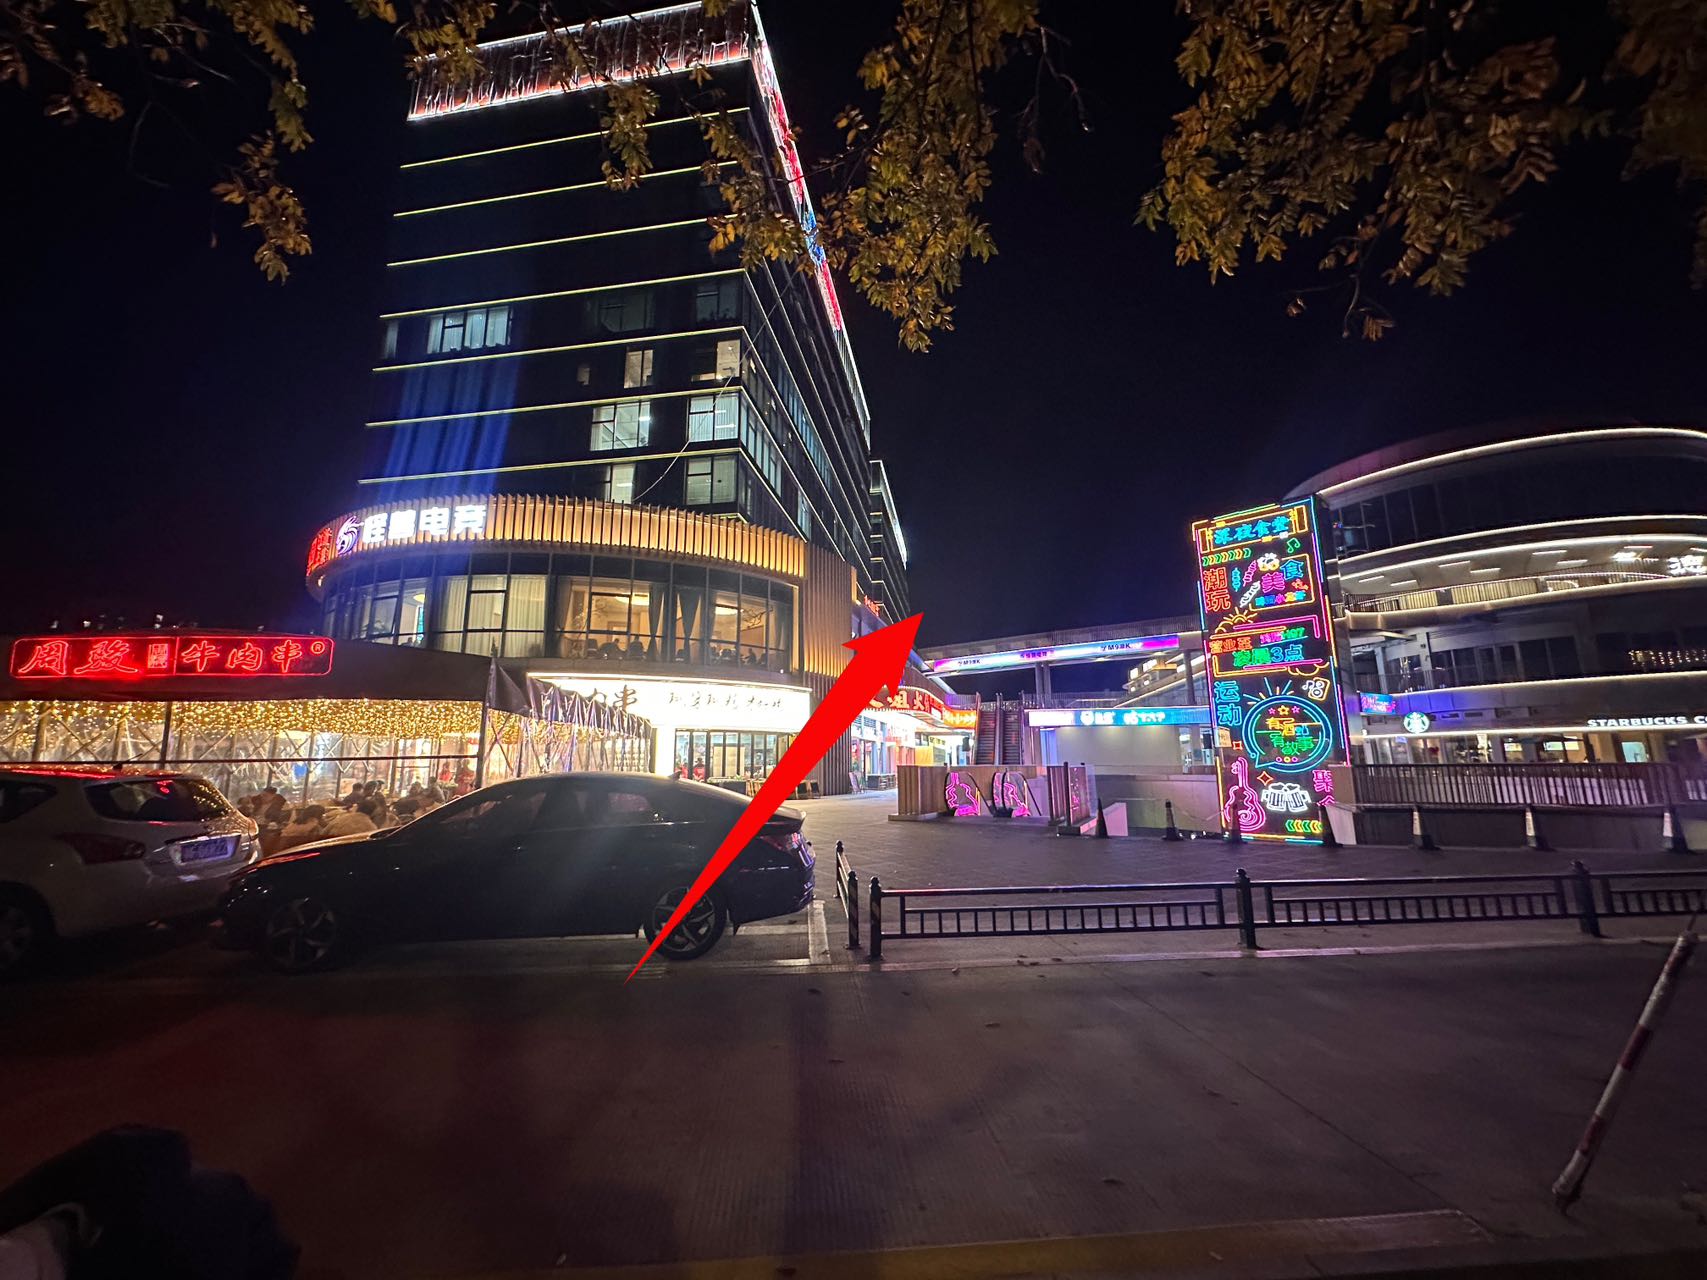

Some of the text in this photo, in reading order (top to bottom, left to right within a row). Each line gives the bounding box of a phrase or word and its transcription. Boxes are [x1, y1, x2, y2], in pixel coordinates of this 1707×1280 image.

[1203, 567, 1231, 611] 潮玩
[181, 640, 302, 673] 牛肉串
[1213, 680, 1242, 727] 运动
[1587, 716, 1687, 727] STARBUCKS
